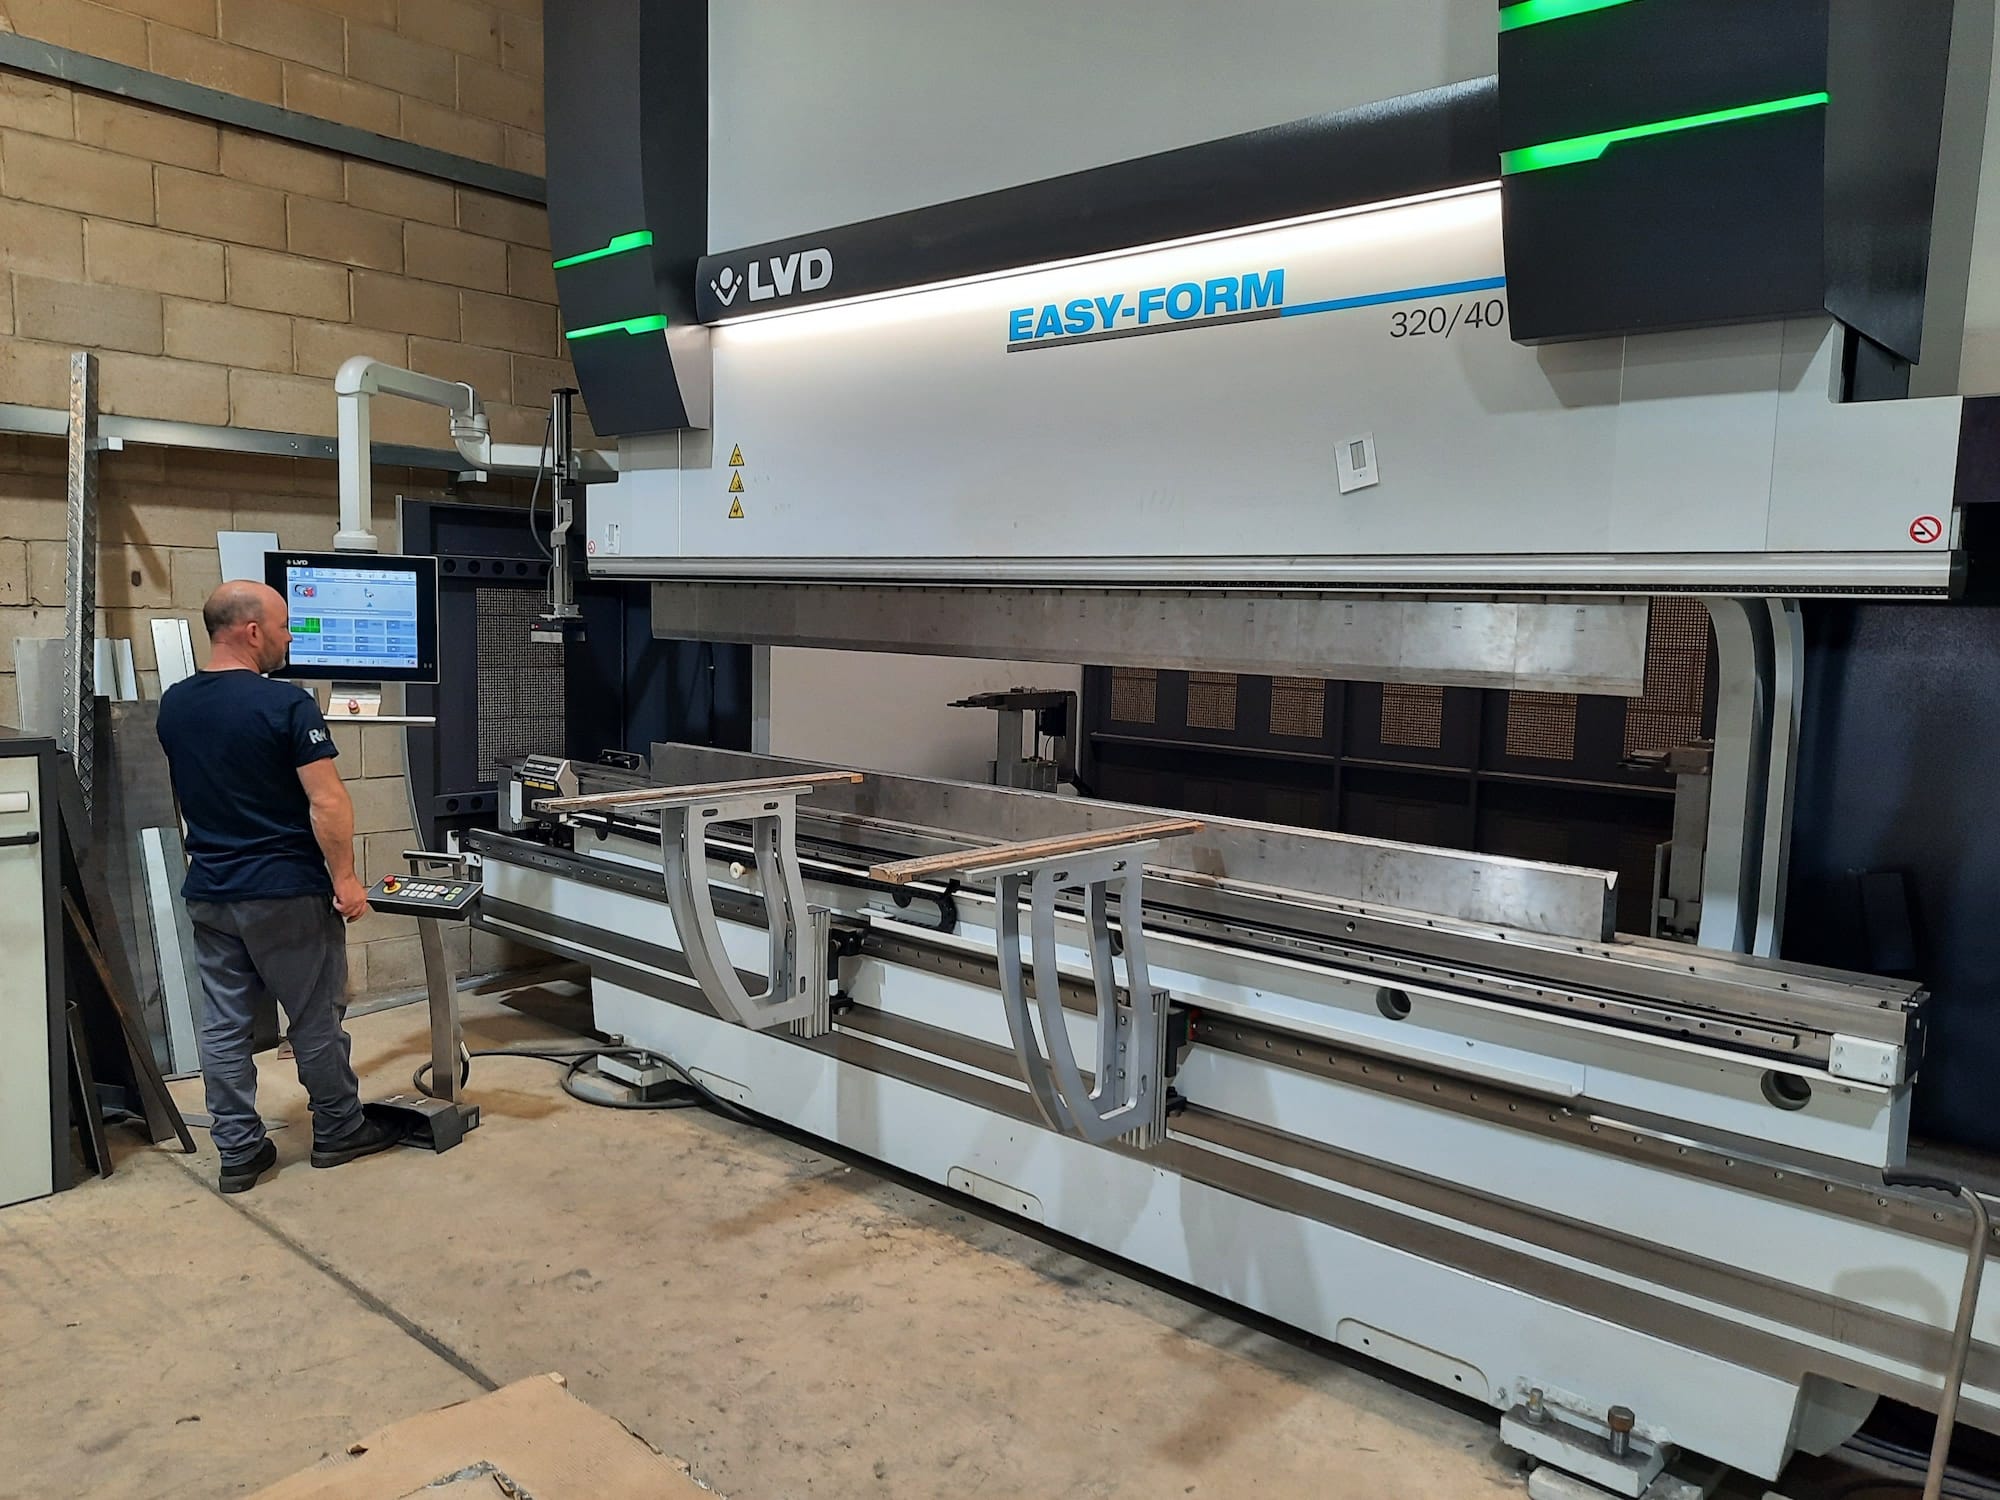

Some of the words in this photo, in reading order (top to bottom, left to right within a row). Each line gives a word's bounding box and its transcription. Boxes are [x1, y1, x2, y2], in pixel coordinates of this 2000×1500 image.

[748, 248, 834, 302] LVD
[1008, 268, 1284, 342] EASY-FORM
[1389, 299, 1504, 339] 320/40
